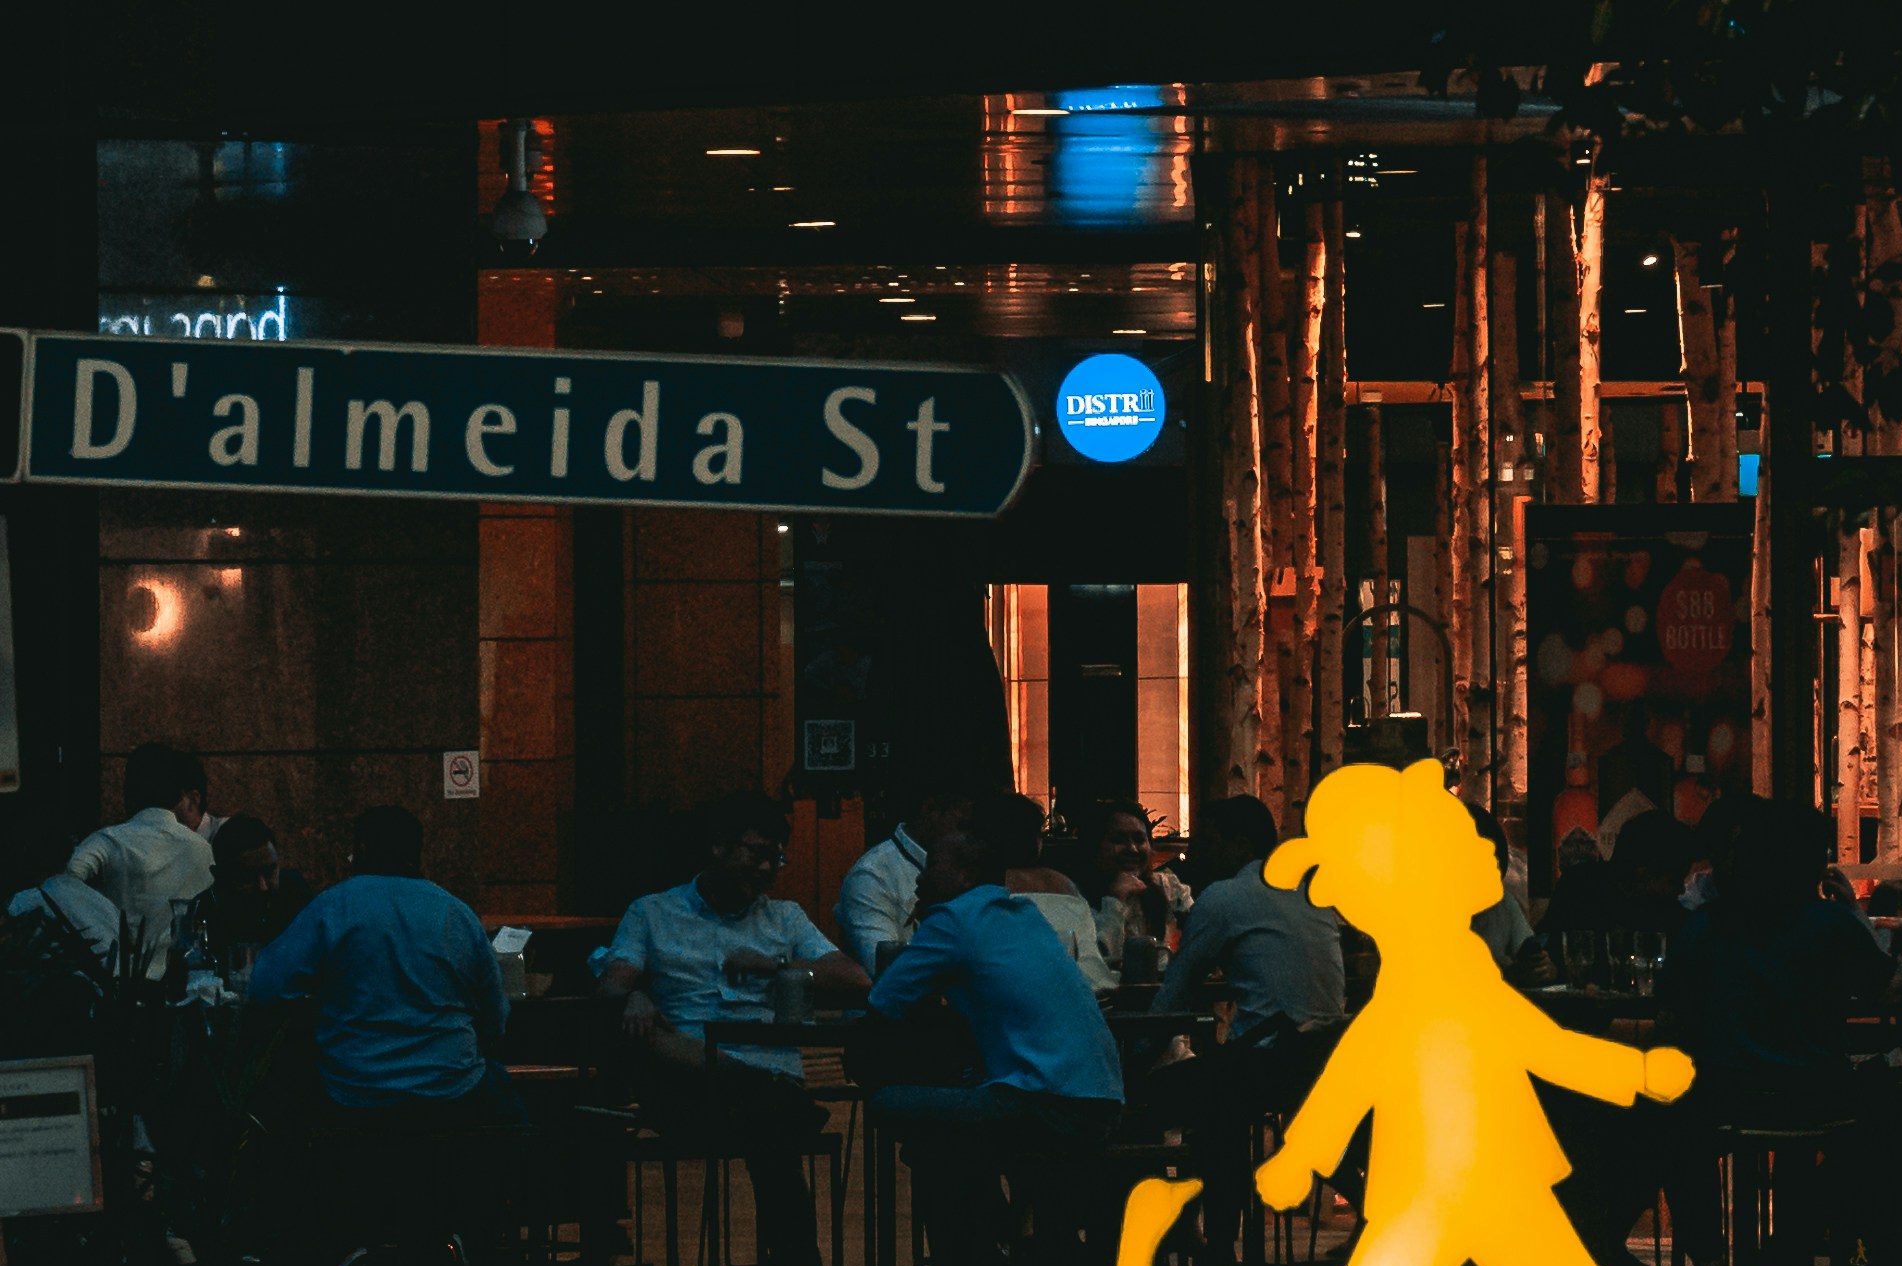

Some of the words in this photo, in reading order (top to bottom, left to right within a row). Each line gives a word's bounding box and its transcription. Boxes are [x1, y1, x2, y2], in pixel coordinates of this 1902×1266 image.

[67, 357, 746, 487] D'almeida
[820, 385, 951, 496] St
[1664, 623, 1729, 650] BOTTLE
